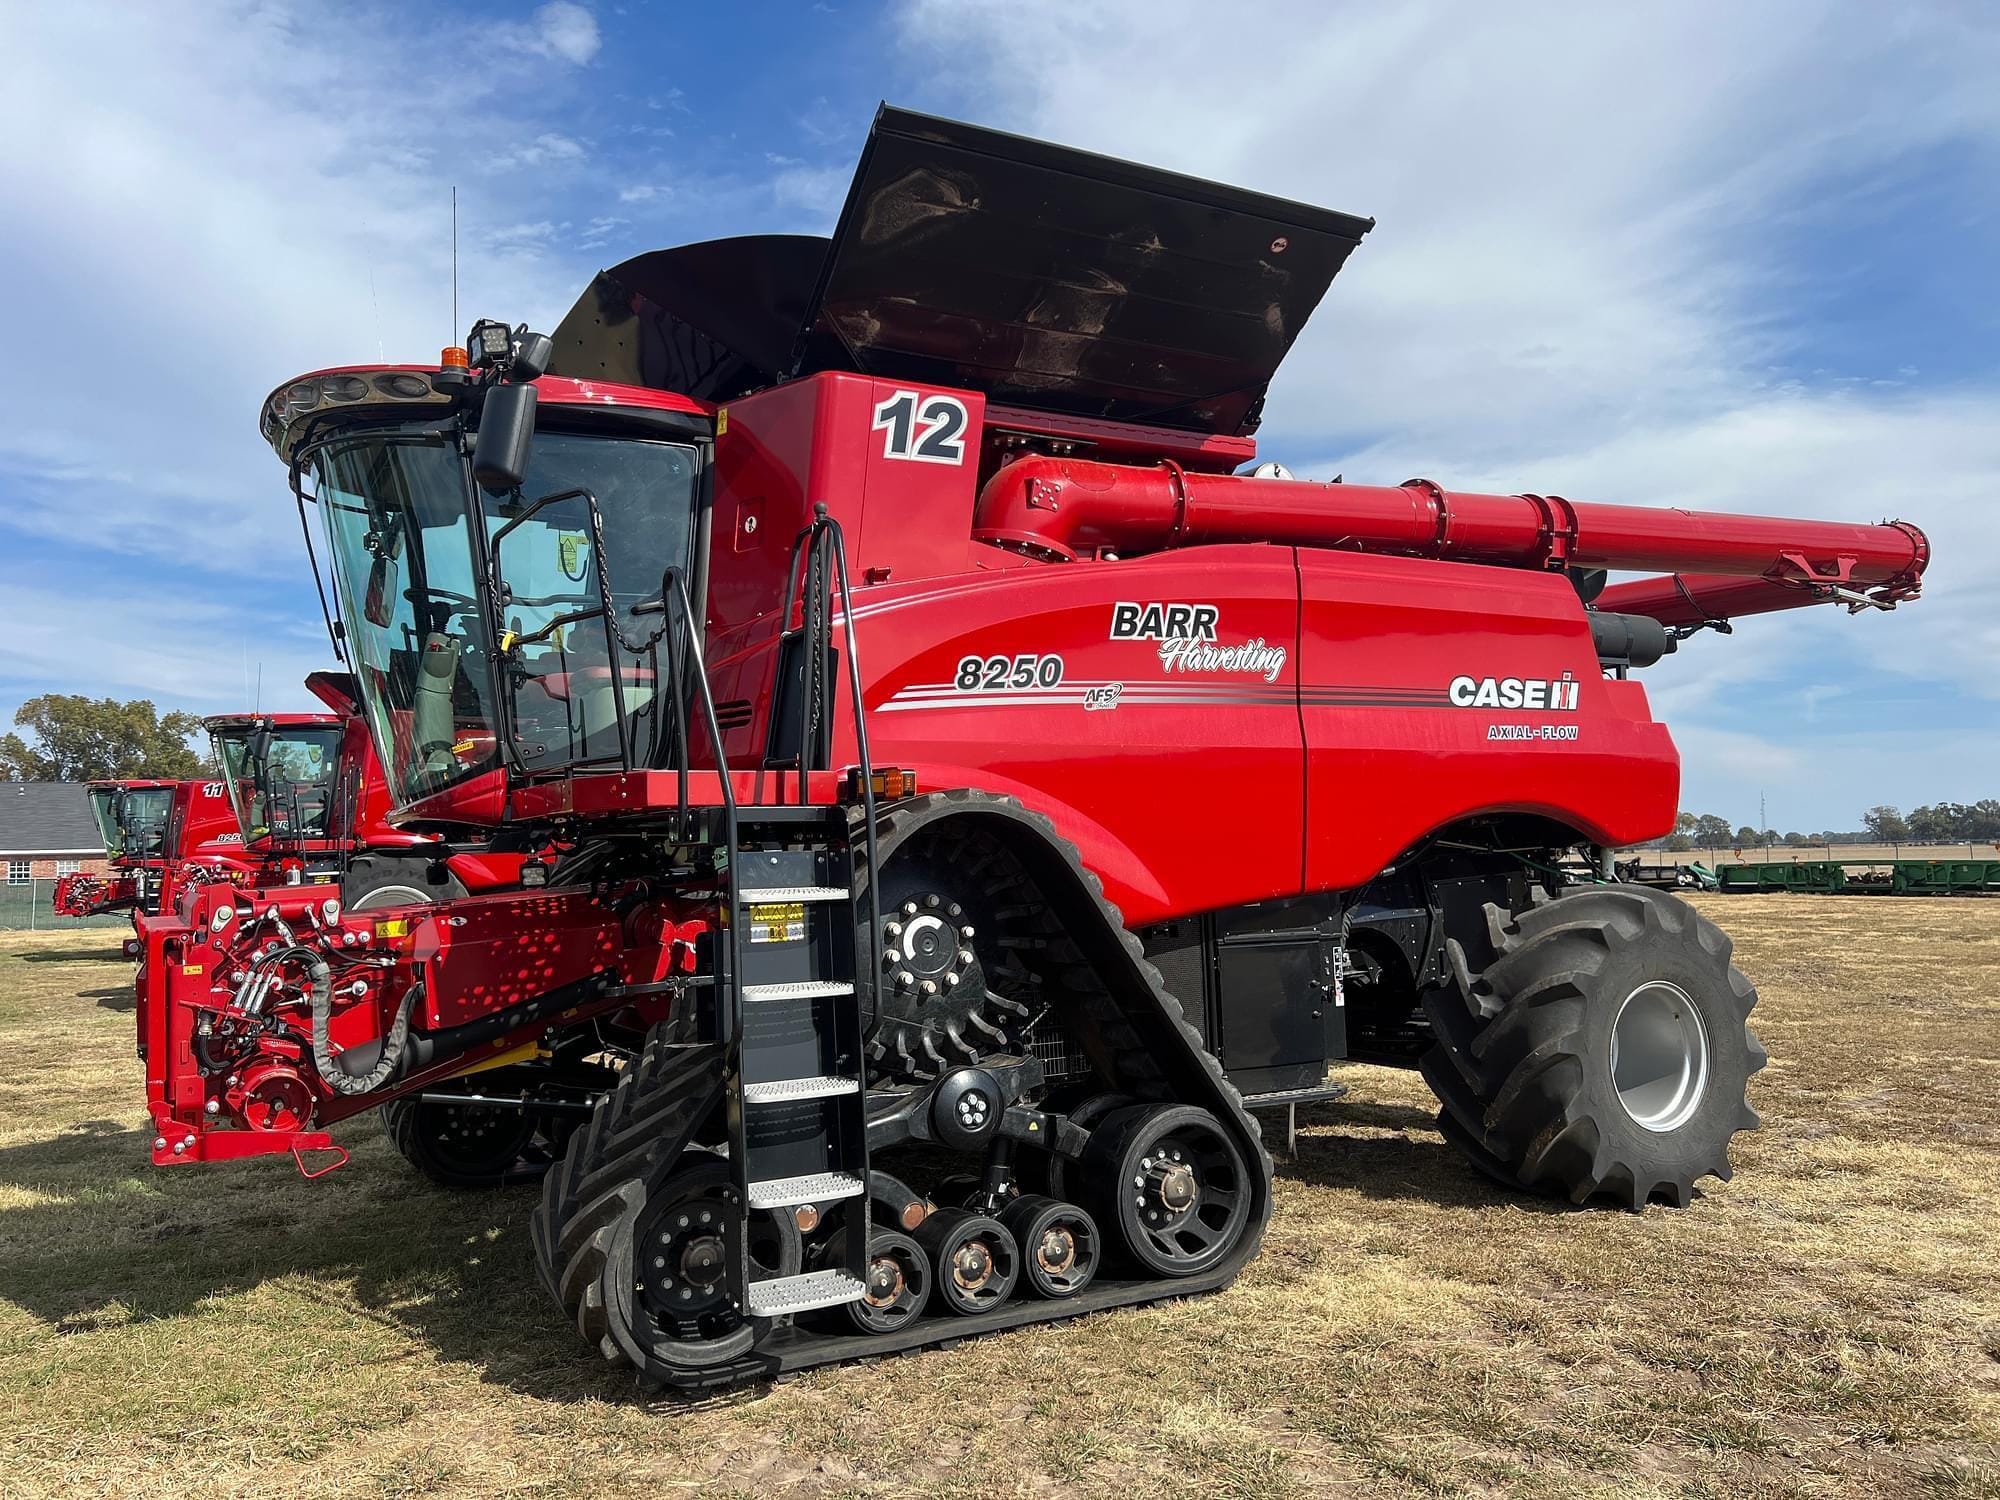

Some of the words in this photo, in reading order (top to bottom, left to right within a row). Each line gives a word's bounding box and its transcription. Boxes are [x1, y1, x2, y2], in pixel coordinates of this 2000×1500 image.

[874, 391, 967, 463] 12
[1111, 603, 1217, 640] BARR
[956, 654, 1063, 690] 8250
[1158, 637, 1285, 682] Harvesting
[1085, 689, 1113, 702] AFS
[1449, 675, 1547, 709] CASE
[1488, 726, 1578, 740] AXIAL-FLOW
[203, 783, 223, 797] 11
